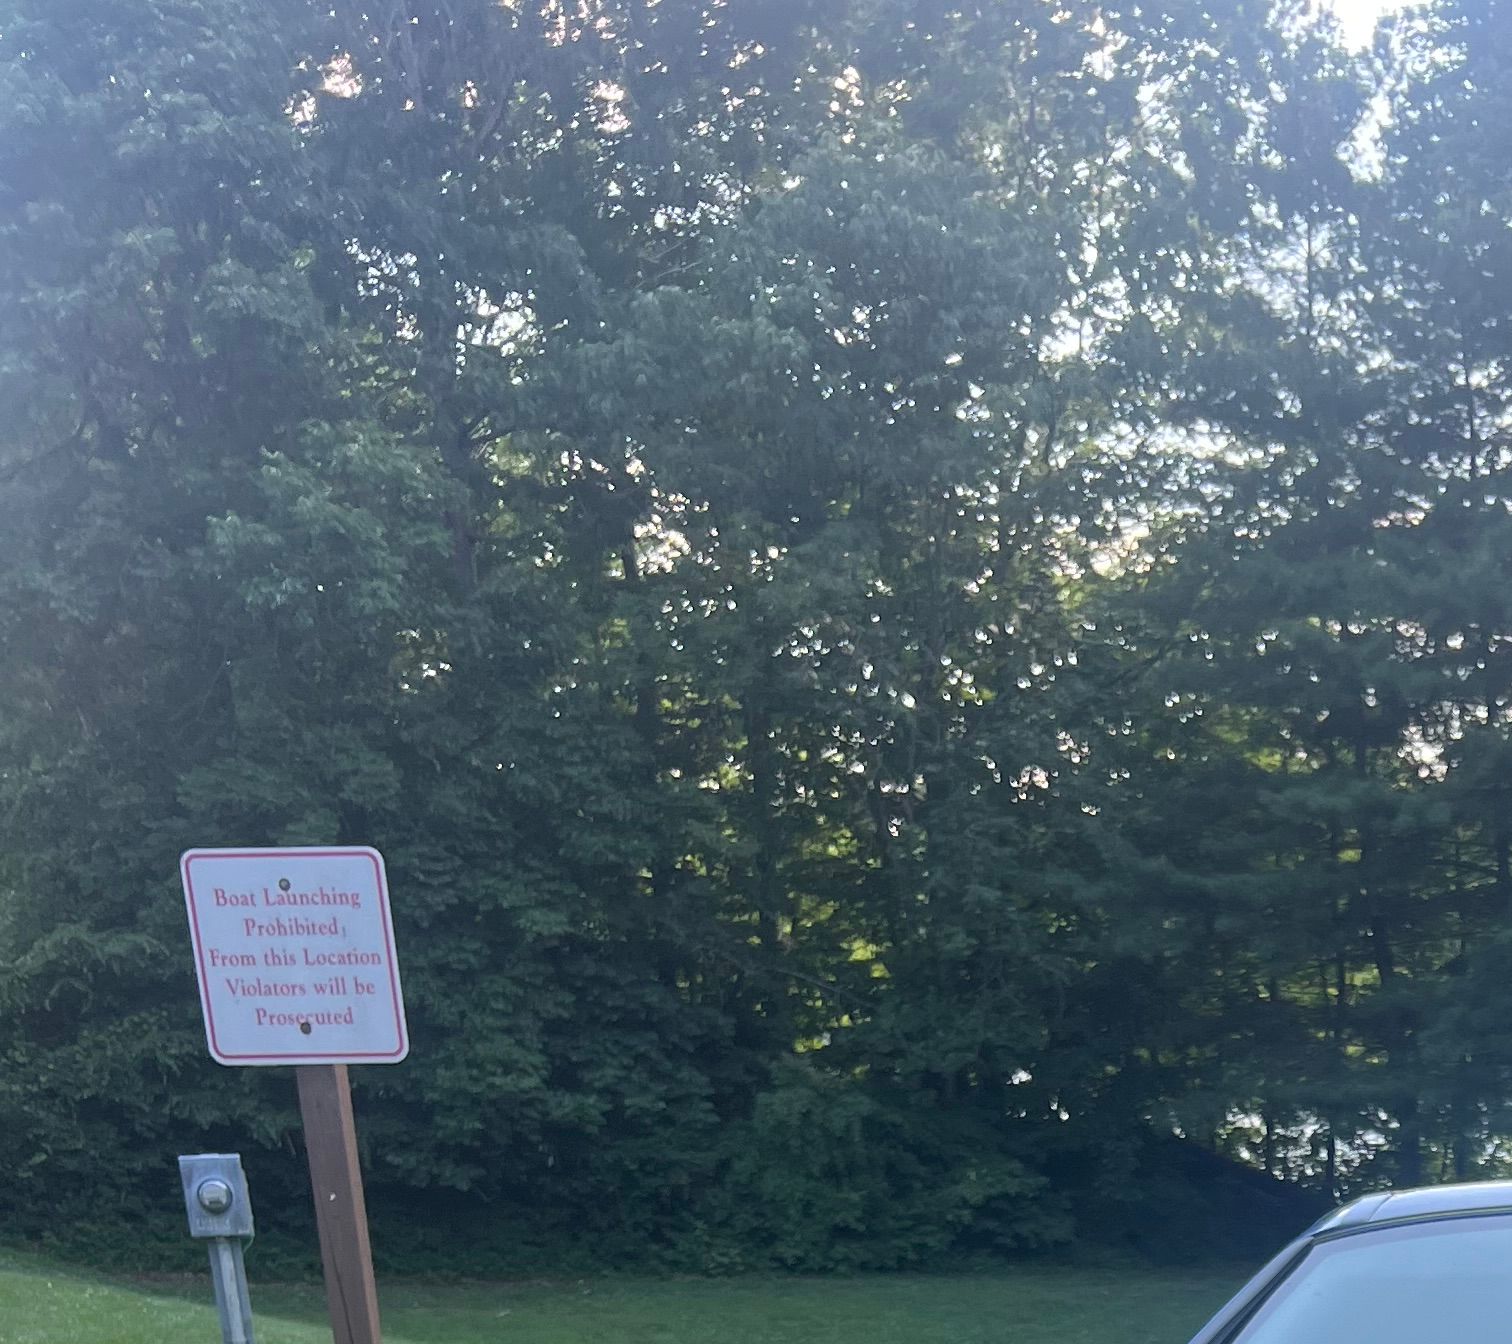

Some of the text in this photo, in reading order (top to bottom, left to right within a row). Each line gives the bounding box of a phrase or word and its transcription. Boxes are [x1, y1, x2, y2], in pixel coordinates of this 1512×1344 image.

[214, 886, 361, 909] Boat Launching
[243, 917, 339, 938] Prohibited
[209, 947, 382, 968] From this Location
[225, 976, 376, 998] Violators will be
[255, 1006, 354, 1026] Prosecuted
